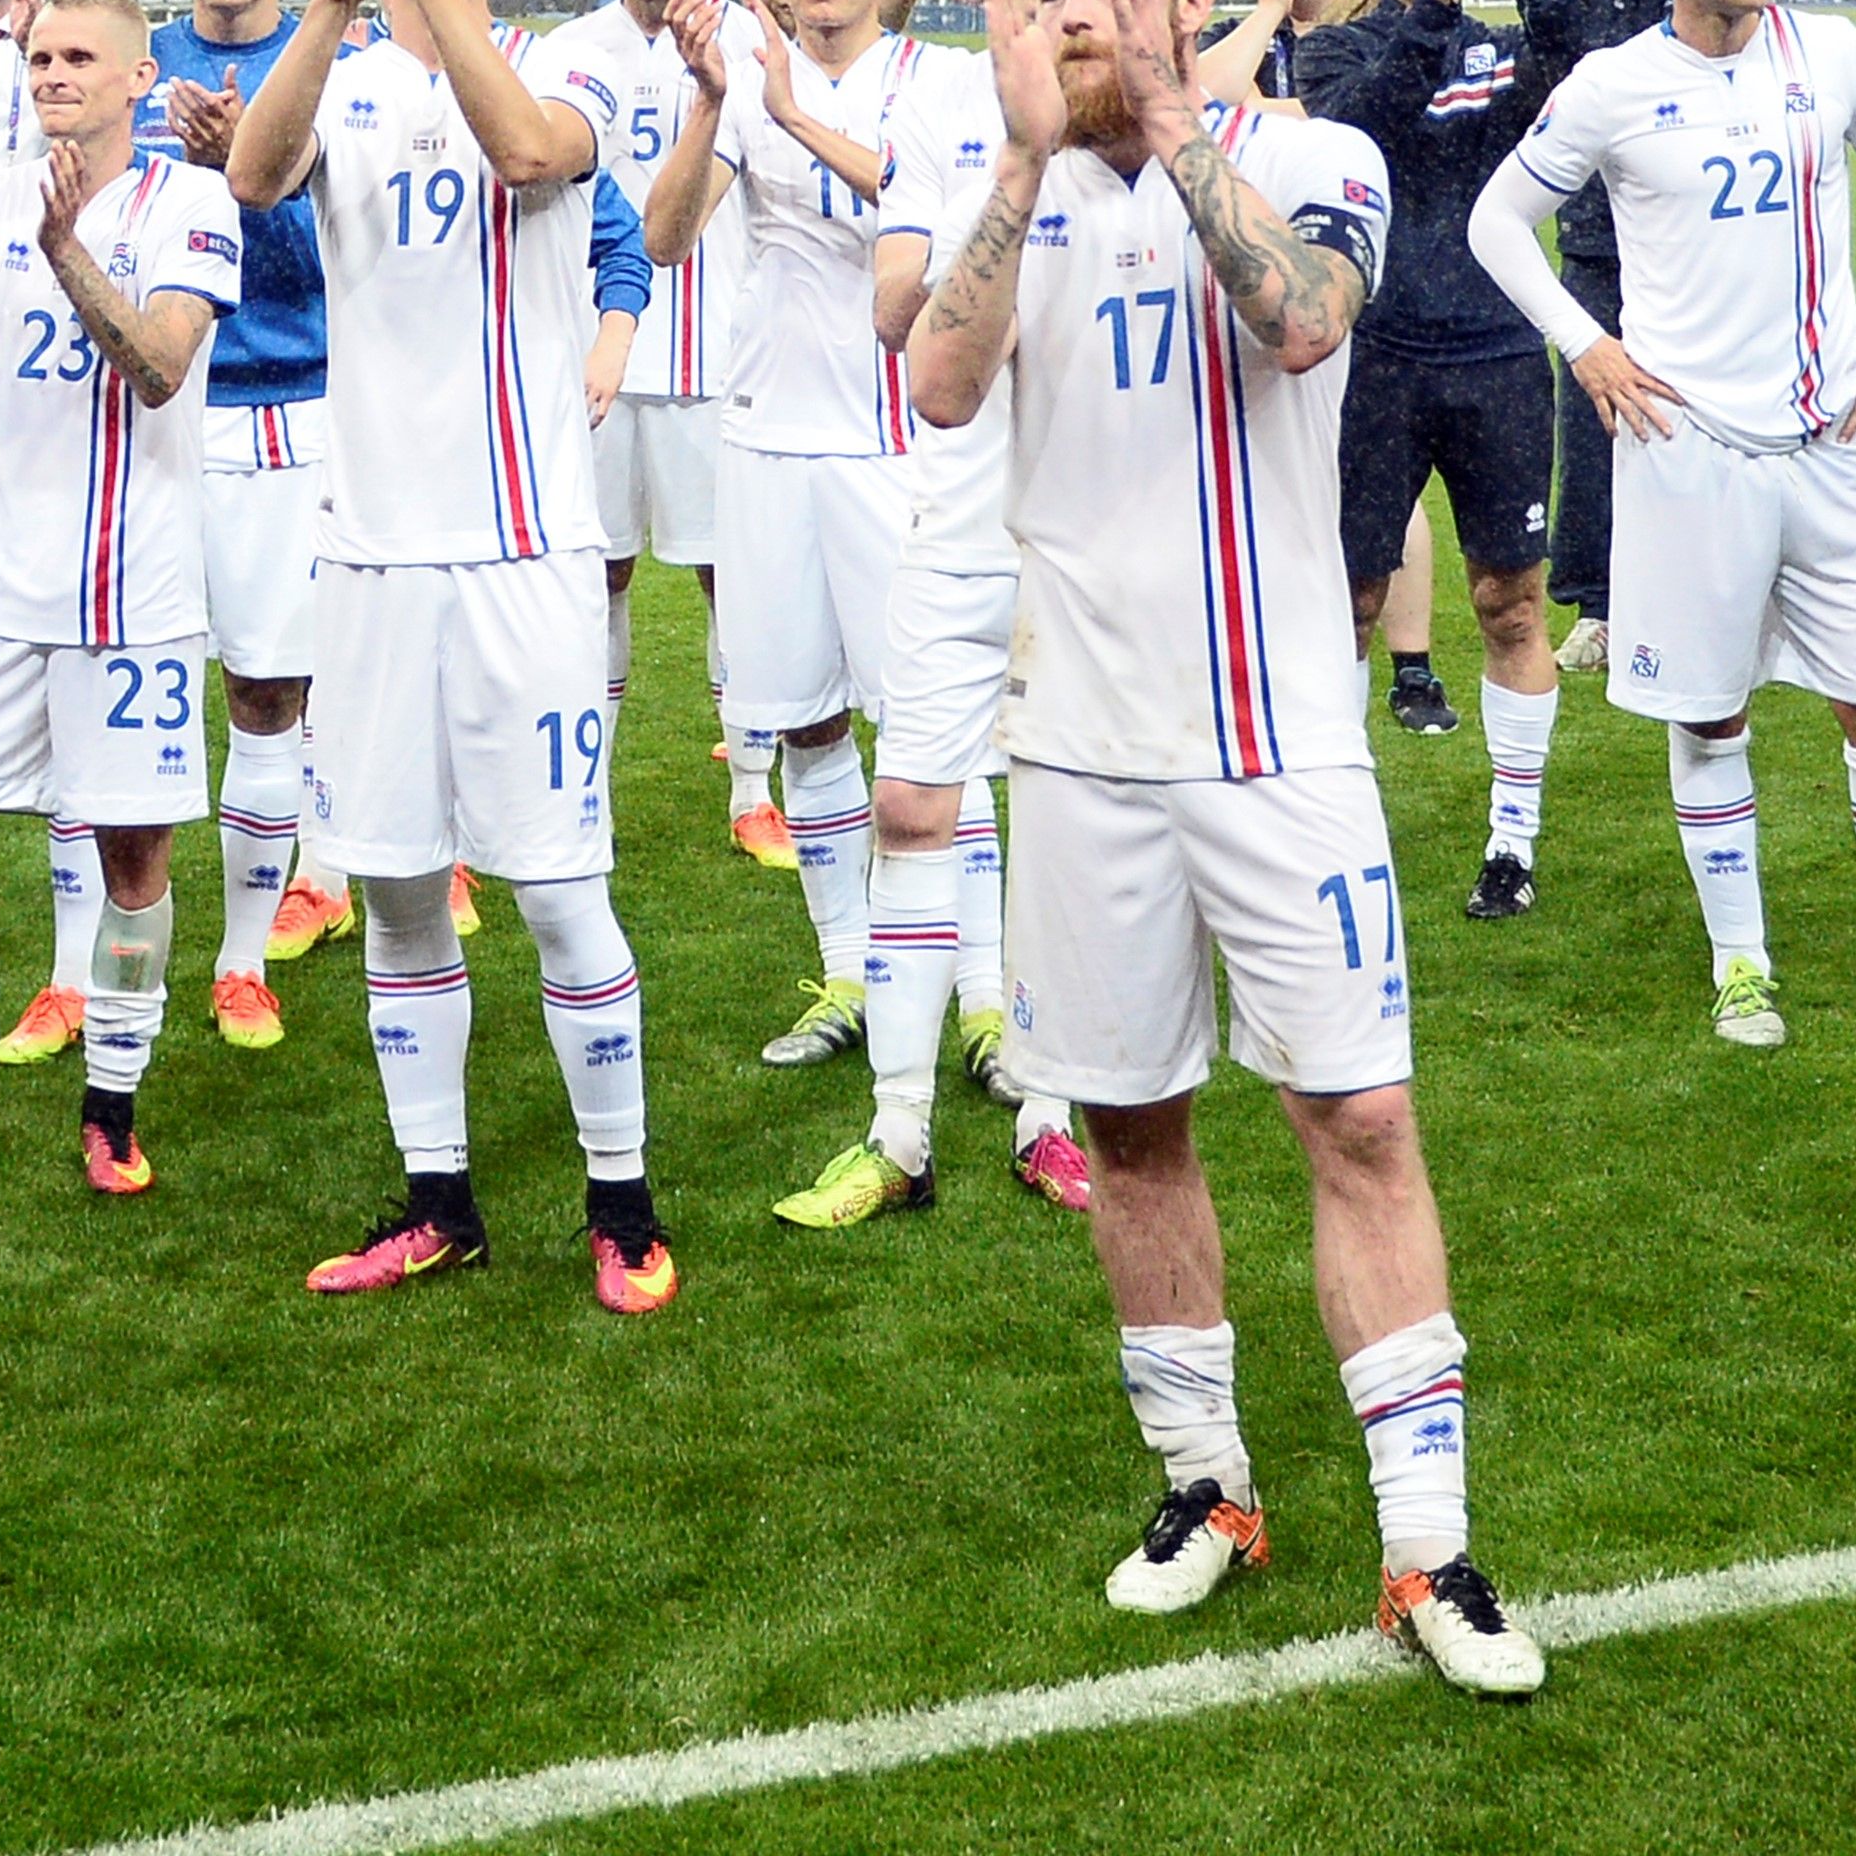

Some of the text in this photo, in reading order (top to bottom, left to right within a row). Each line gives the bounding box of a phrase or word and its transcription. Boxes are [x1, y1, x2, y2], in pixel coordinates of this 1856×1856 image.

[630, 106, 662, 161] 5
[386, 168, 464, 246] 19
[1702, 148, 1789, 221] 22
[17, 309, 95, 382] 23
[1096, 286, 1175, 393] 17
[105, 658, 190, 731] 23
[535, 709, 603, 790] 19
[1316, 864, 1397, 971] 17
